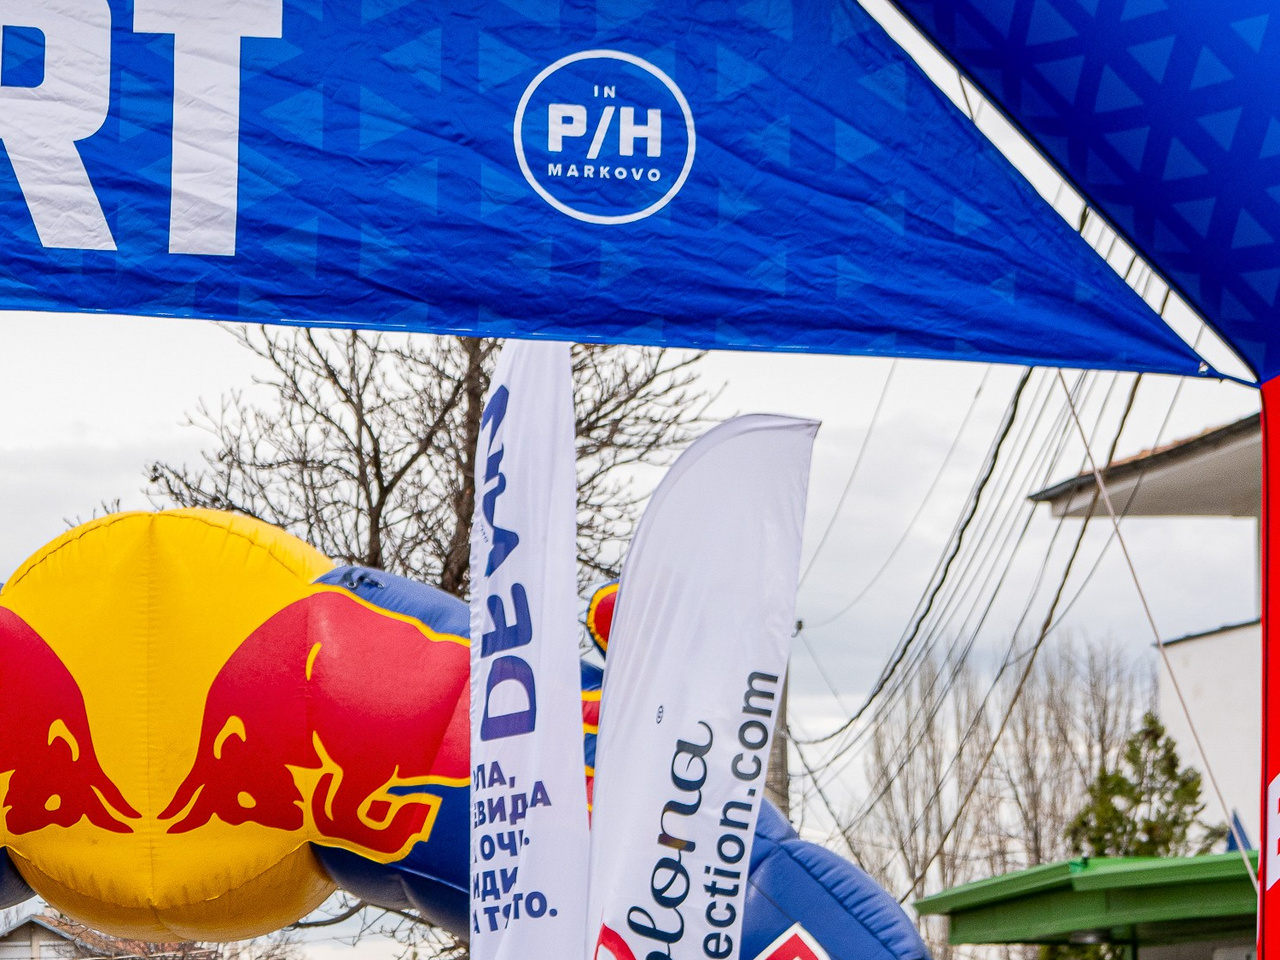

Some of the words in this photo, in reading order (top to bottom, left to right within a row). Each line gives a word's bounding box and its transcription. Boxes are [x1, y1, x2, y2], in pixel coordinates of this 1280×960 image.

[593, 84, 616, 98] IN
[548, 103, 662, 160] P/H
[548, 163, 662, 182] MARKOVO
